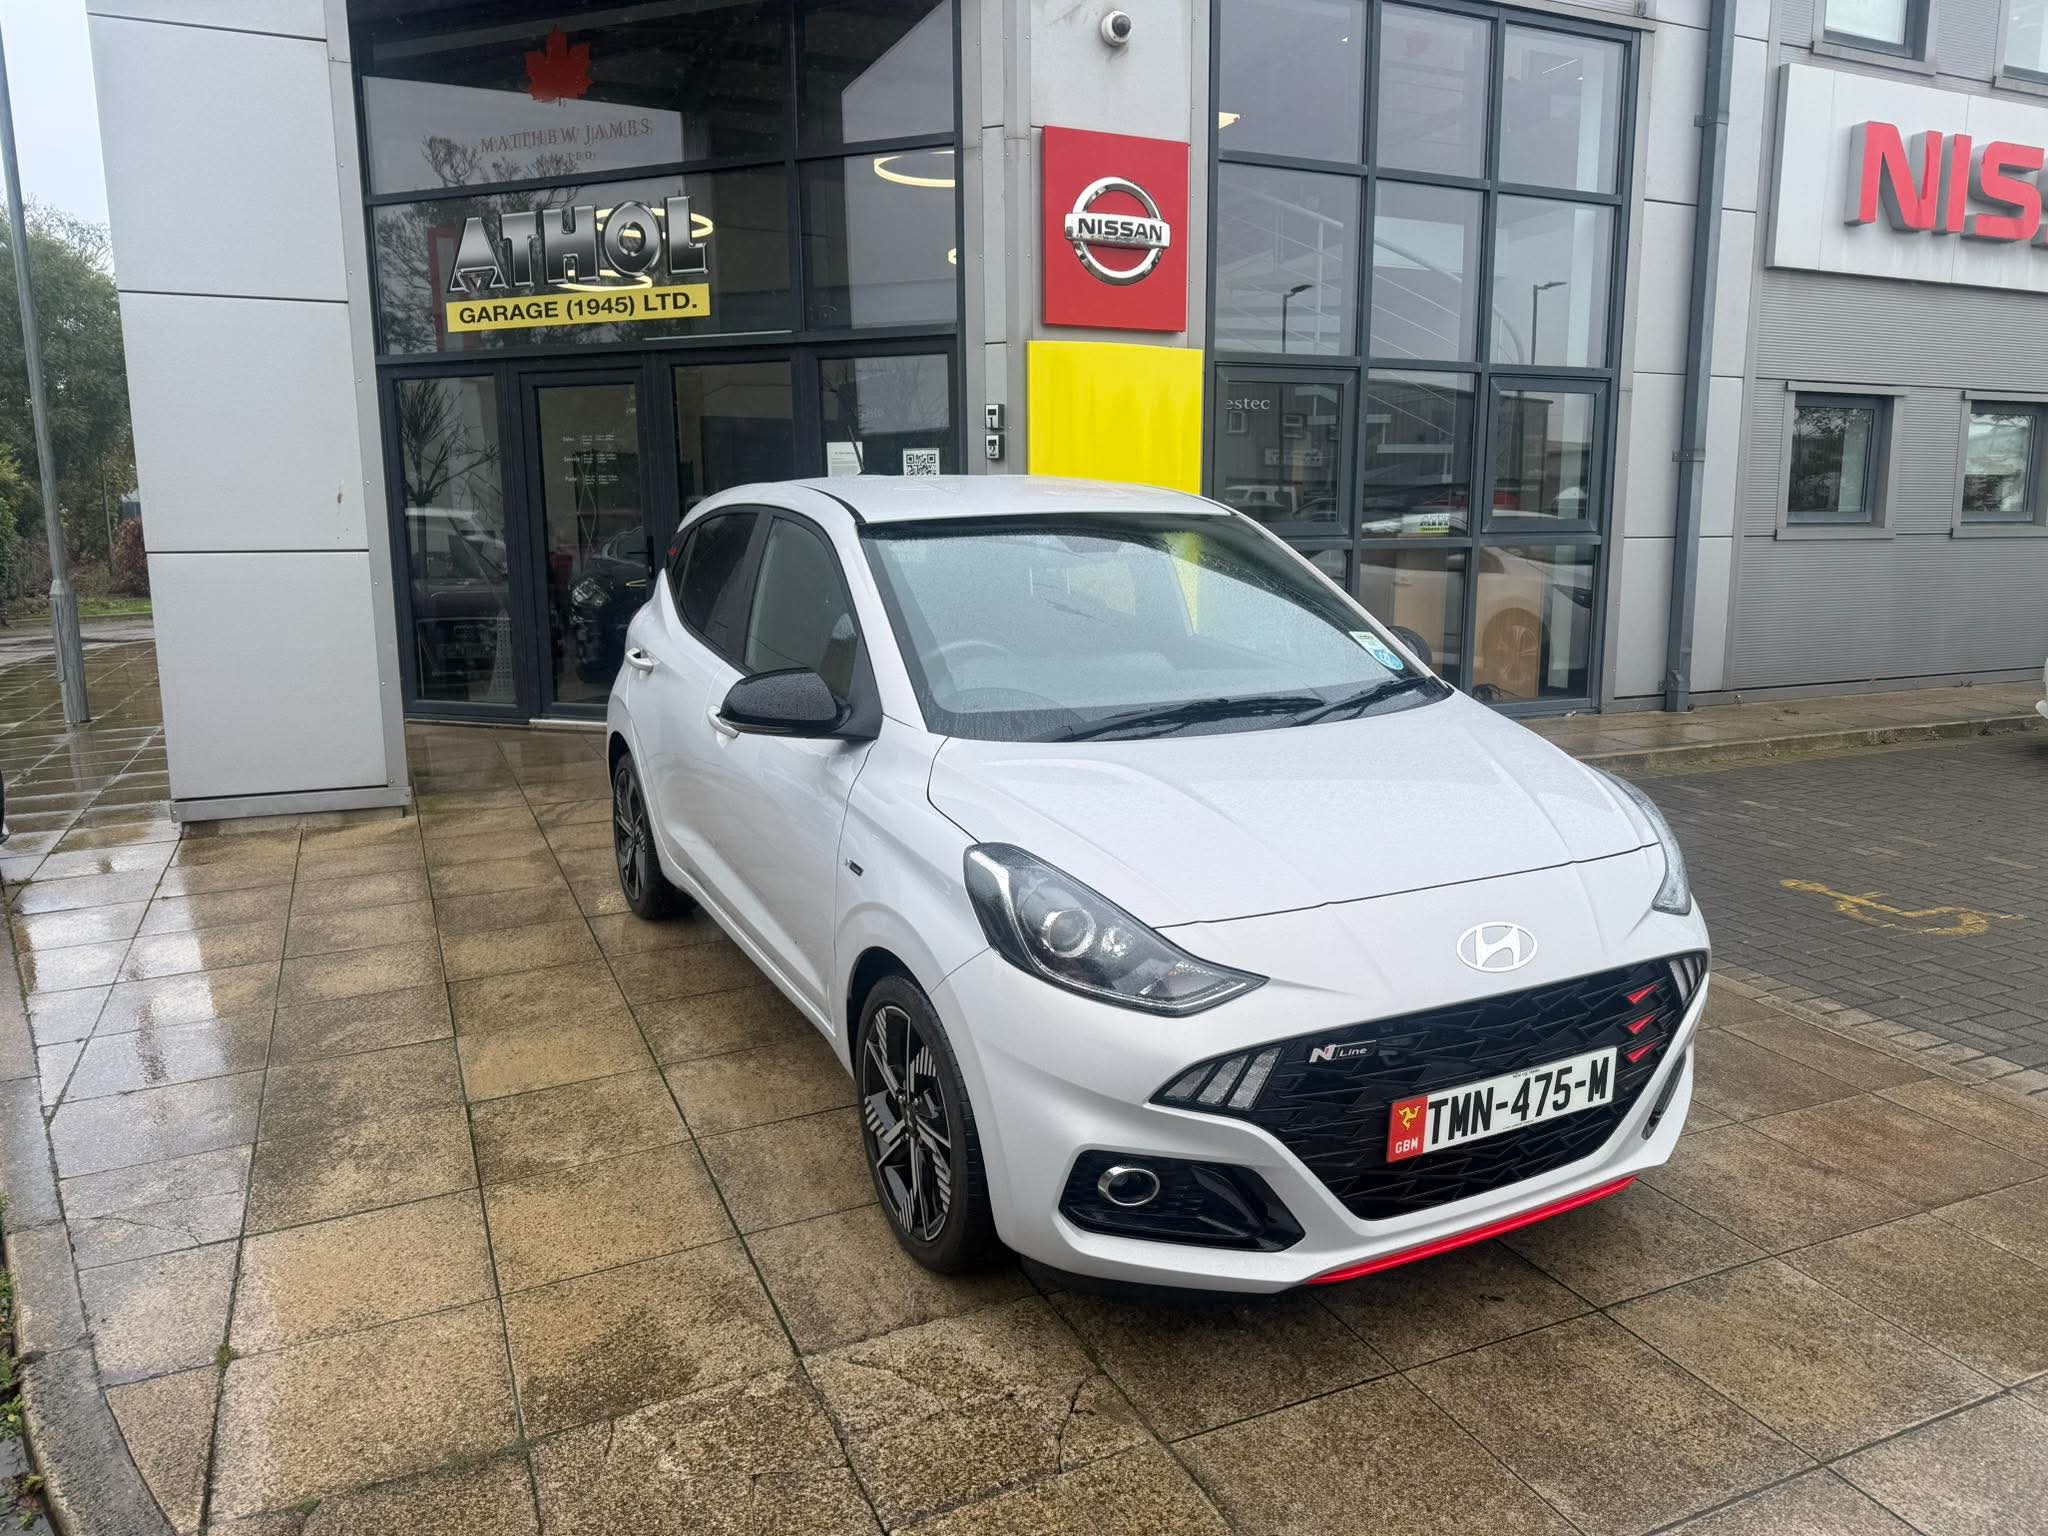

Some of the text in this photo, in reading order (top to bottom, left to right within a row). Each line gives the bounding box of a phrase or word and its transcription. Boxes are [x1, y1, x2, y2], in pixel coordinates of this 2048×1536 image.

[480, 118, 653, 153] MATTHEW JAMES
[1845, 119, 2048, 246] NIS
[448, 196, 709, 293] ATHOL
[1078, 218, 1162, 241] NISSAN
[459, 291, 698, 324] GARAGE (1945) LTD.
[1309, 1044, 1369, 1064] N Line
[1428, 1057, 1609, 1145] TMN-475-M
[1395, 1136, 1419, 1154] GBM
